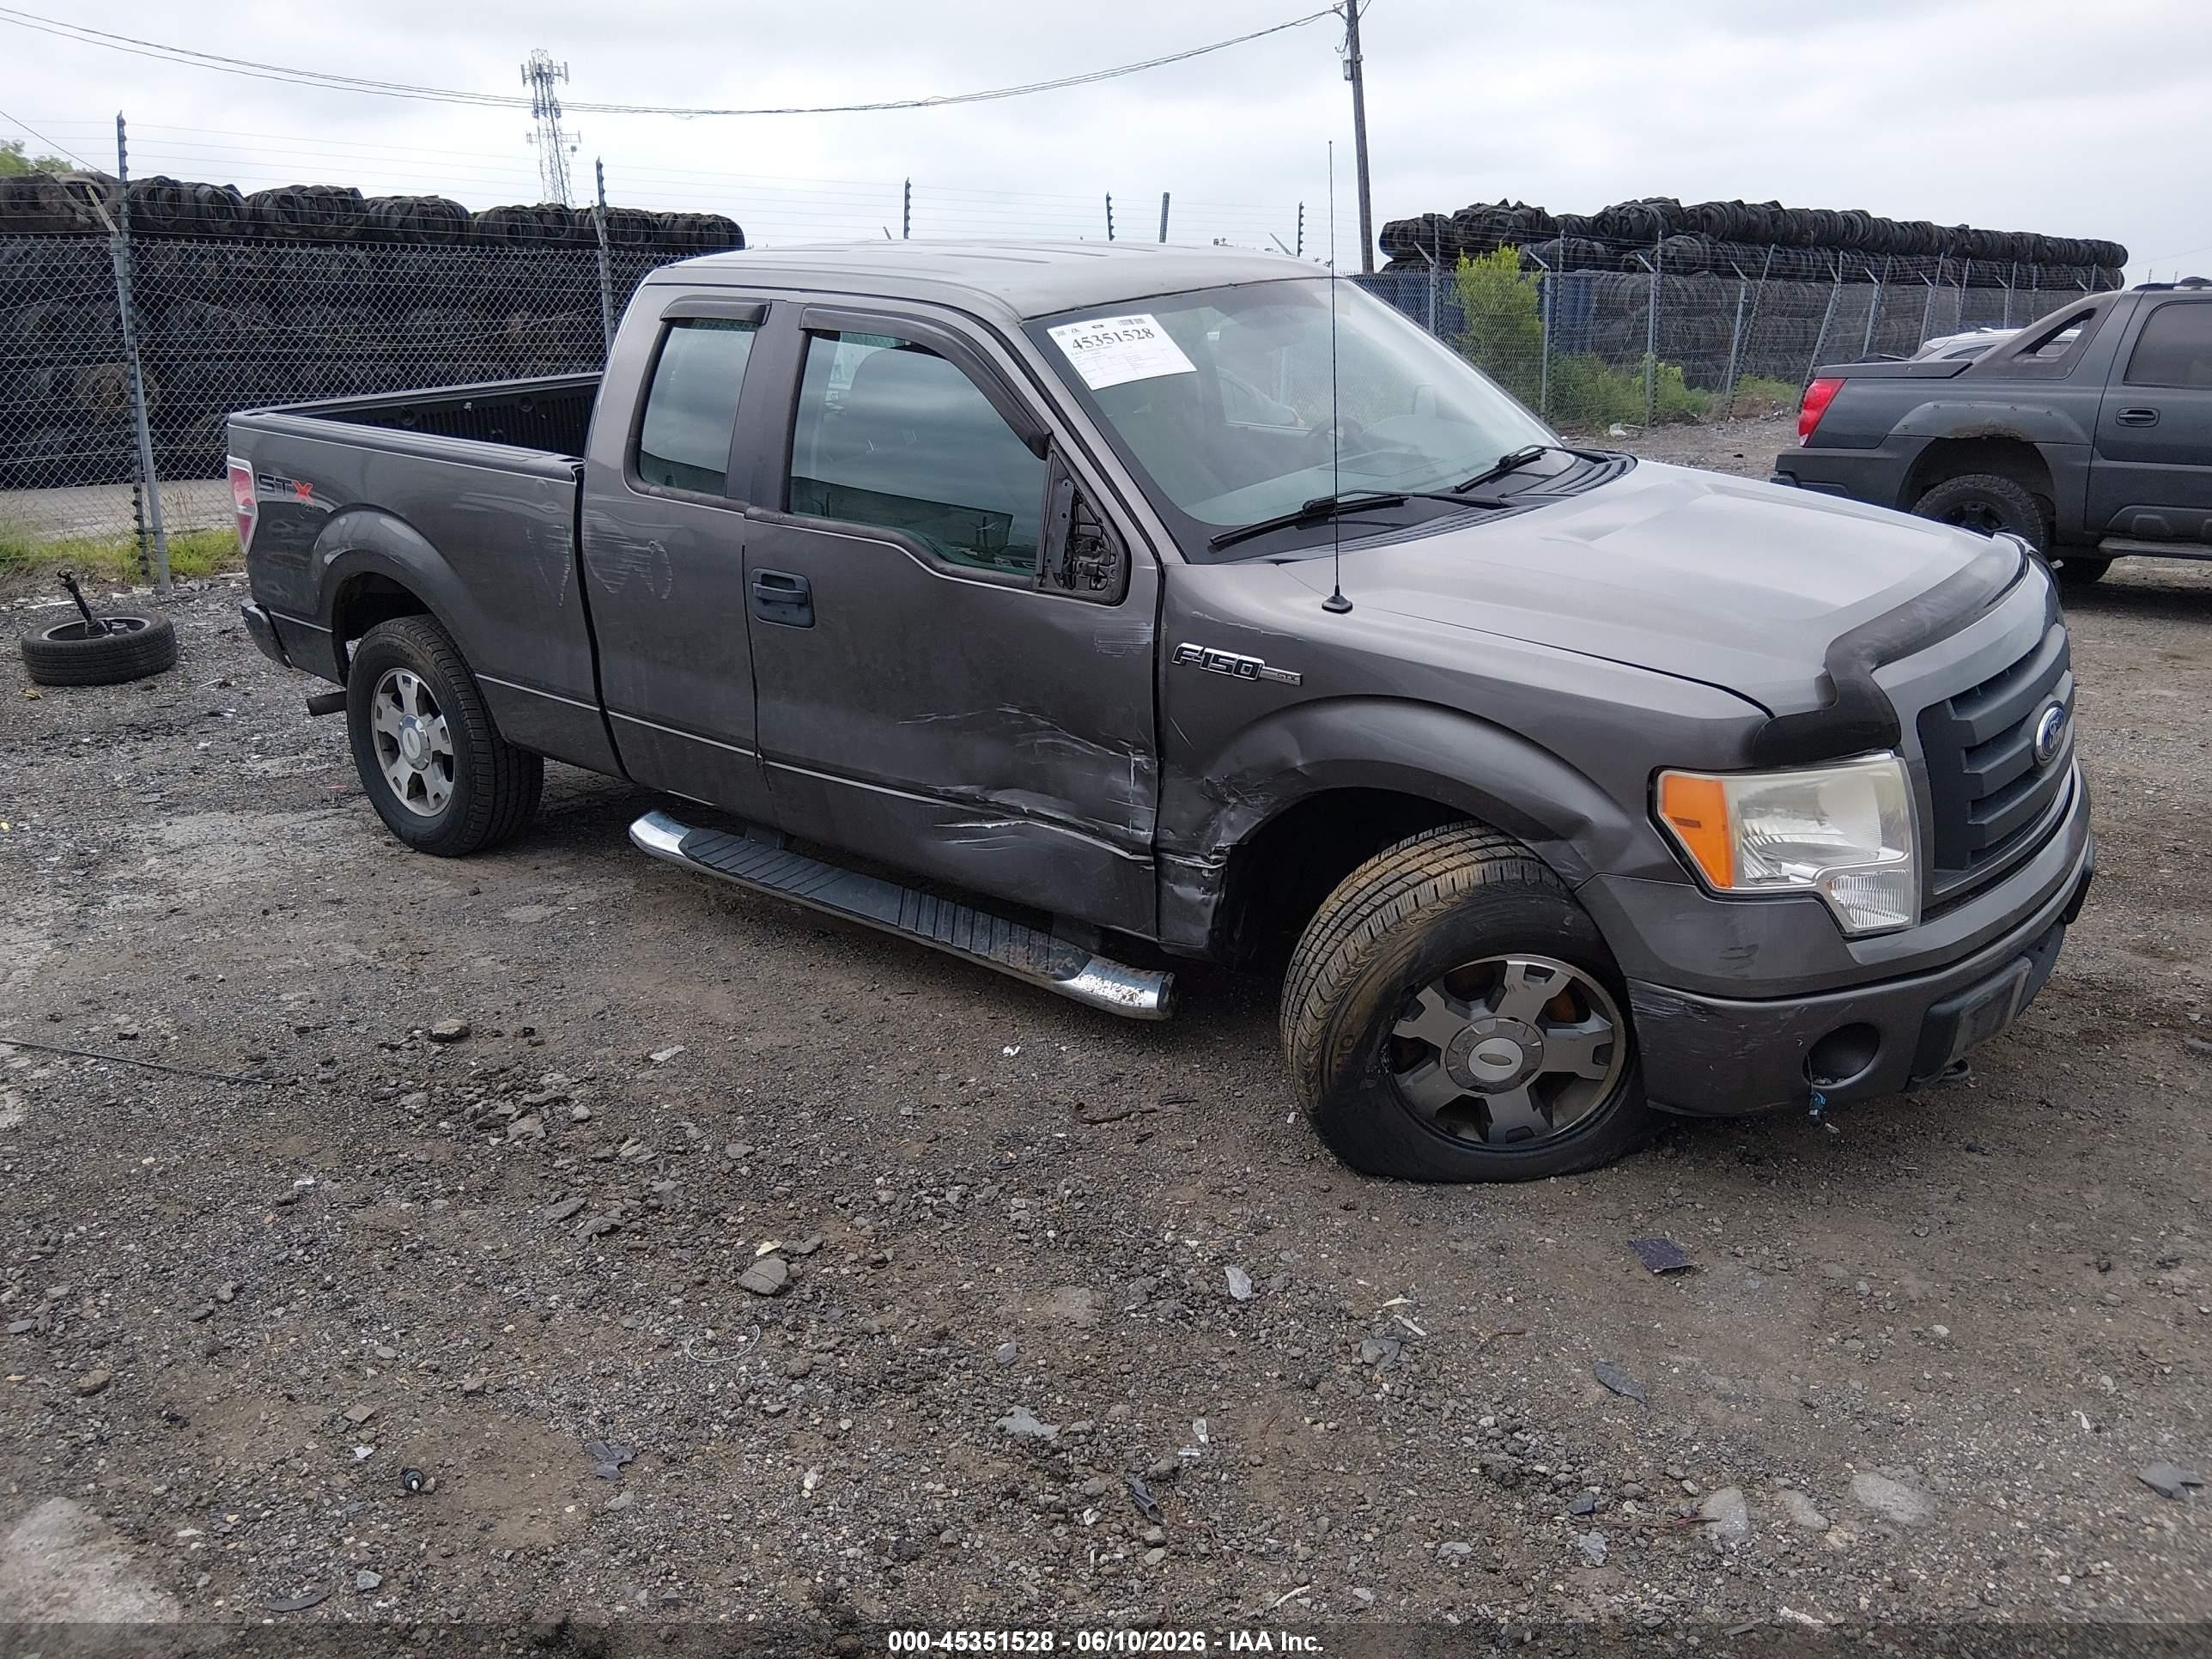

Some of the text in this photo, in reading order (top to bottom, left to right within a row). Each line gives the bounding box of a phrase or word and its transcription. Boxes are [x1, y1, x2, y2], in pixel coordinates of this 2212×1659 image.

[1073, 327, 1155, 350] 45351528
[258, 472, 314, 505] STX
[1277, 672, 1298, 683] STX
